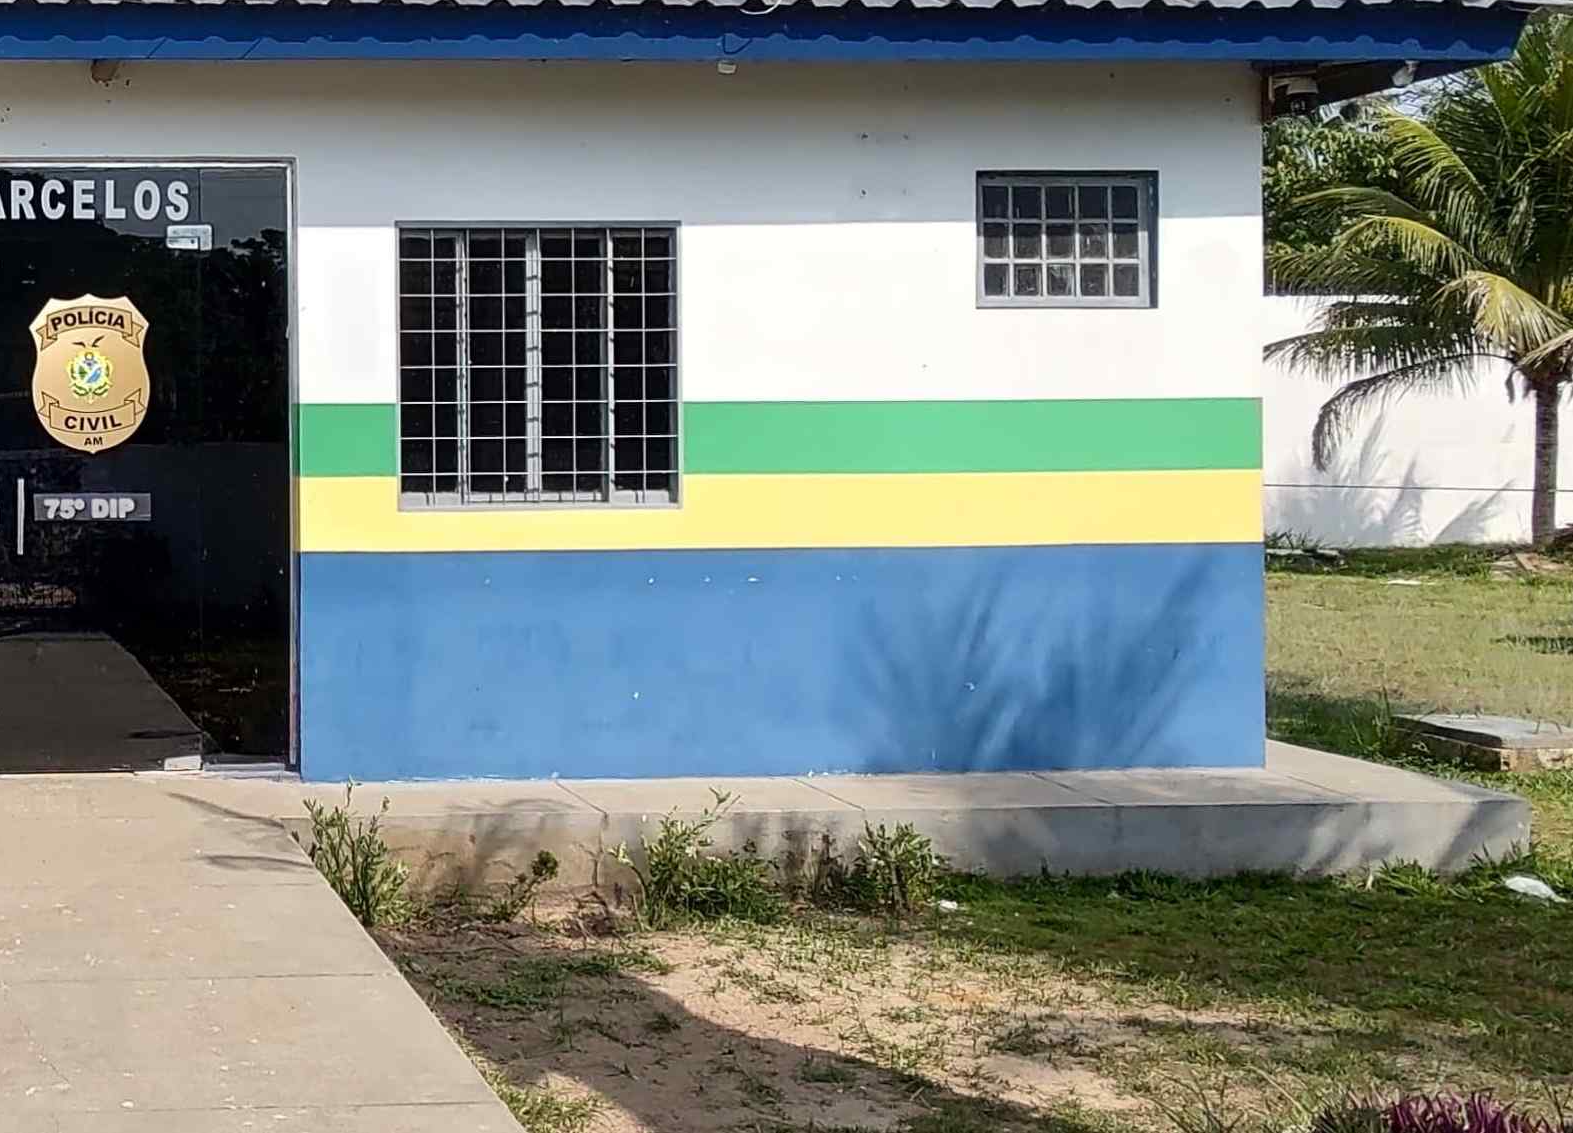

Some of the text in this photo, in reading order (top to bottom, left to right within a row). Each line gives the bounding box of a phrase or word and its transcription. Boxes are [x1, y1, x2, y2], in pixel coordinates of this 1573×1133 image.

[51, 309, 125, 331] POLÍCIA
[64, 414, 122, 431] CIVIL
[84, 437, 103, 446] AM
[91, 498, 135, 519] DIP
